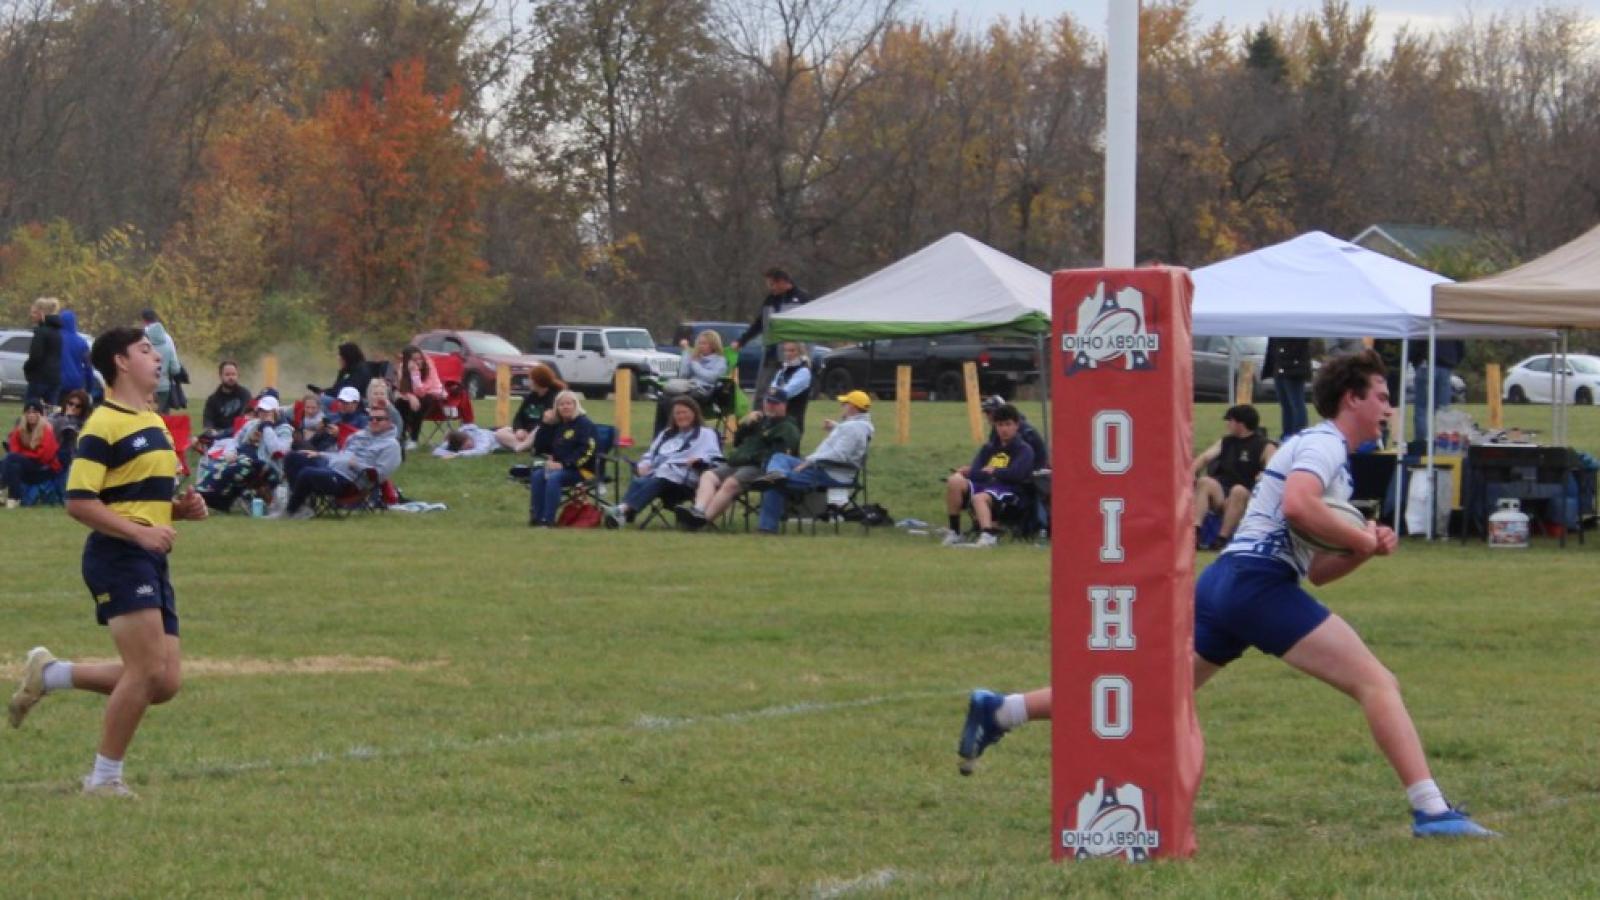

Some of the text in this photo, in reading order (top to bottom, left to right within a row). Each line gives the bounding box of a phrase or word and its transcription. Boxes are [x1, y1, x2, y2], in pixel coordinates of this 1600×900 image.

[1064, 335, 1156, 349] RUGBY OHIO
[1064, 831, 1156, 845] RUGBY OHIO
